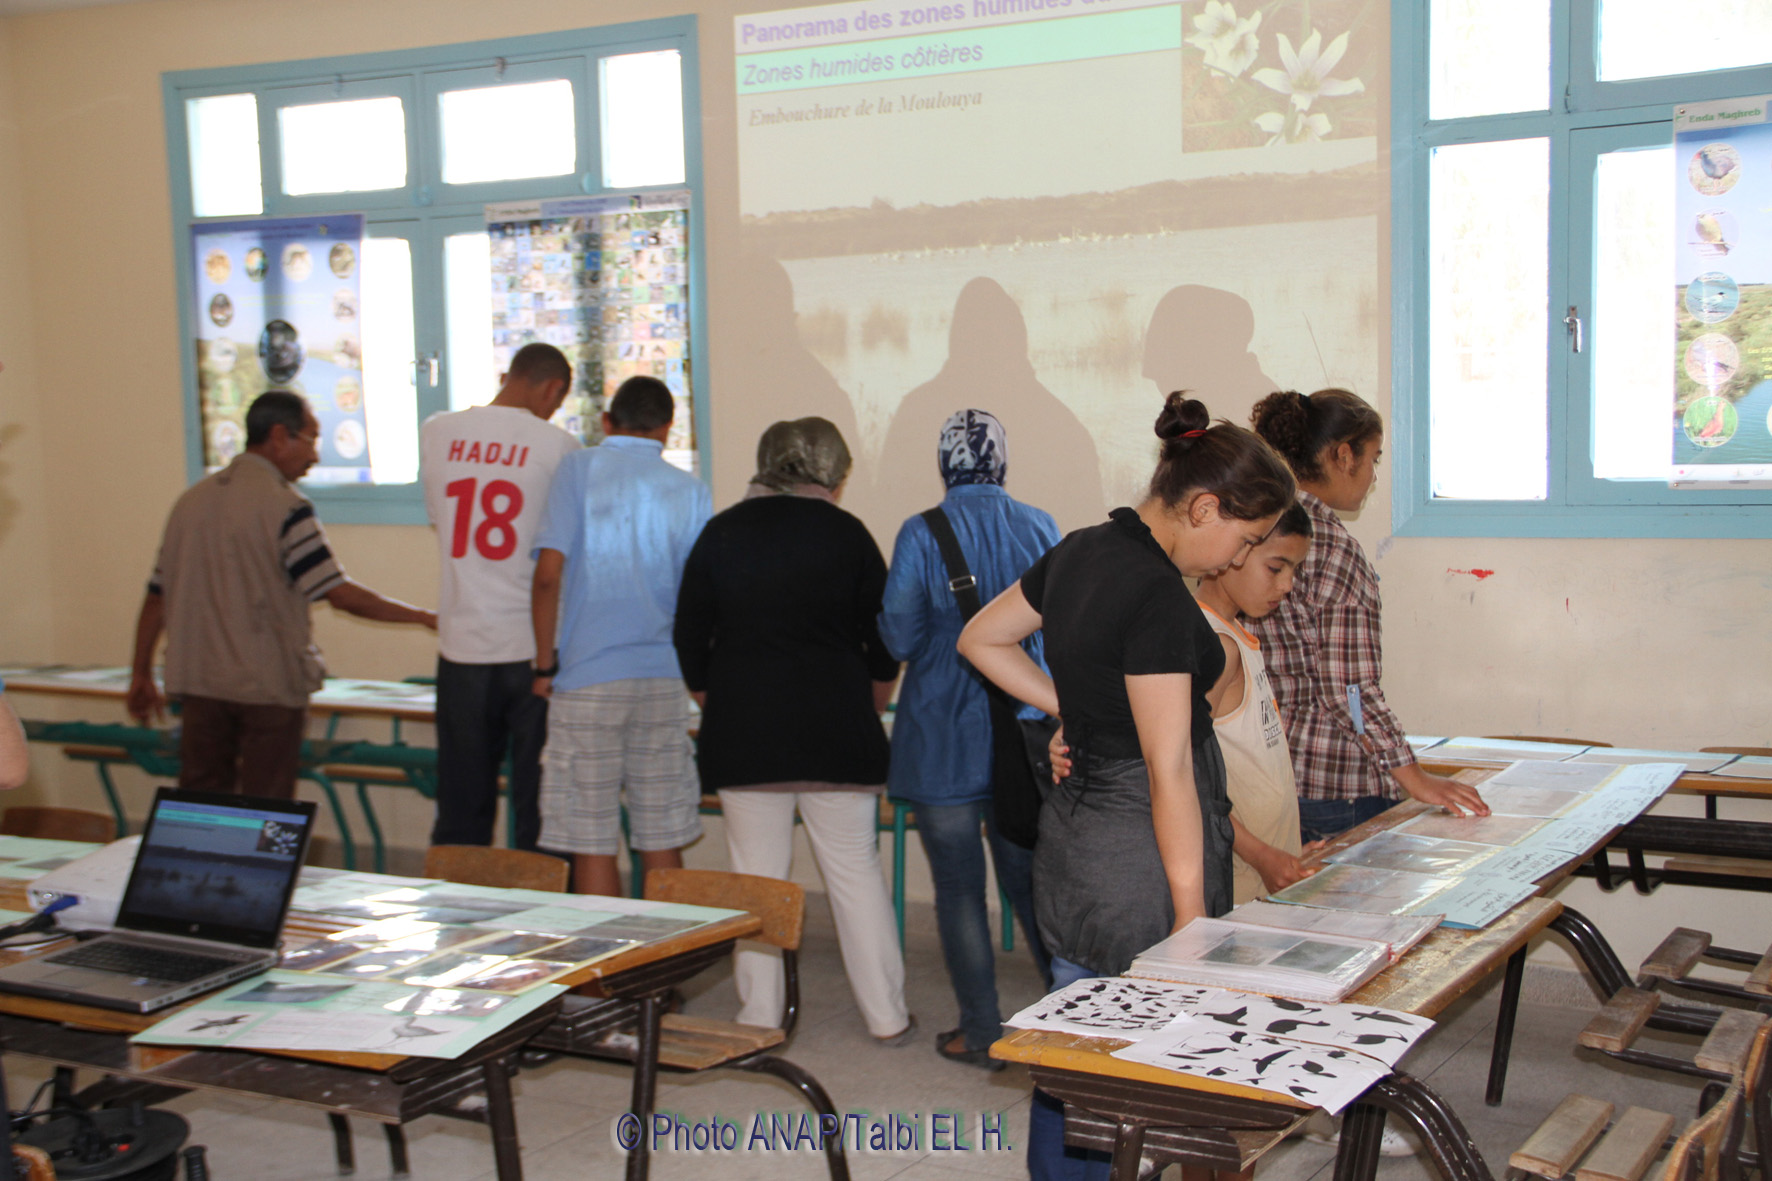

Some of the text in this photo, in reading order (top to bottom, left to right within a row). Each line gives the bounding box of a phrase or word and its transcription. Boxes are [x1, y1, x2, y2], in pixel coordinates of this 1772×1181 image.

[742, 17, 848, 44] Panorama
[854, 10, 893, 31] des
[899, 2, 965, 26] zones
[743, 43, 983, 86] Zones humides côtières
[749, 91, 983, 126] Embouchure de la Moulouya
[1689, 108, 1762, 123] Enda Maghreb
[447, 440, 530, 467] HADJI
[445, 477, 524, 561] 18
